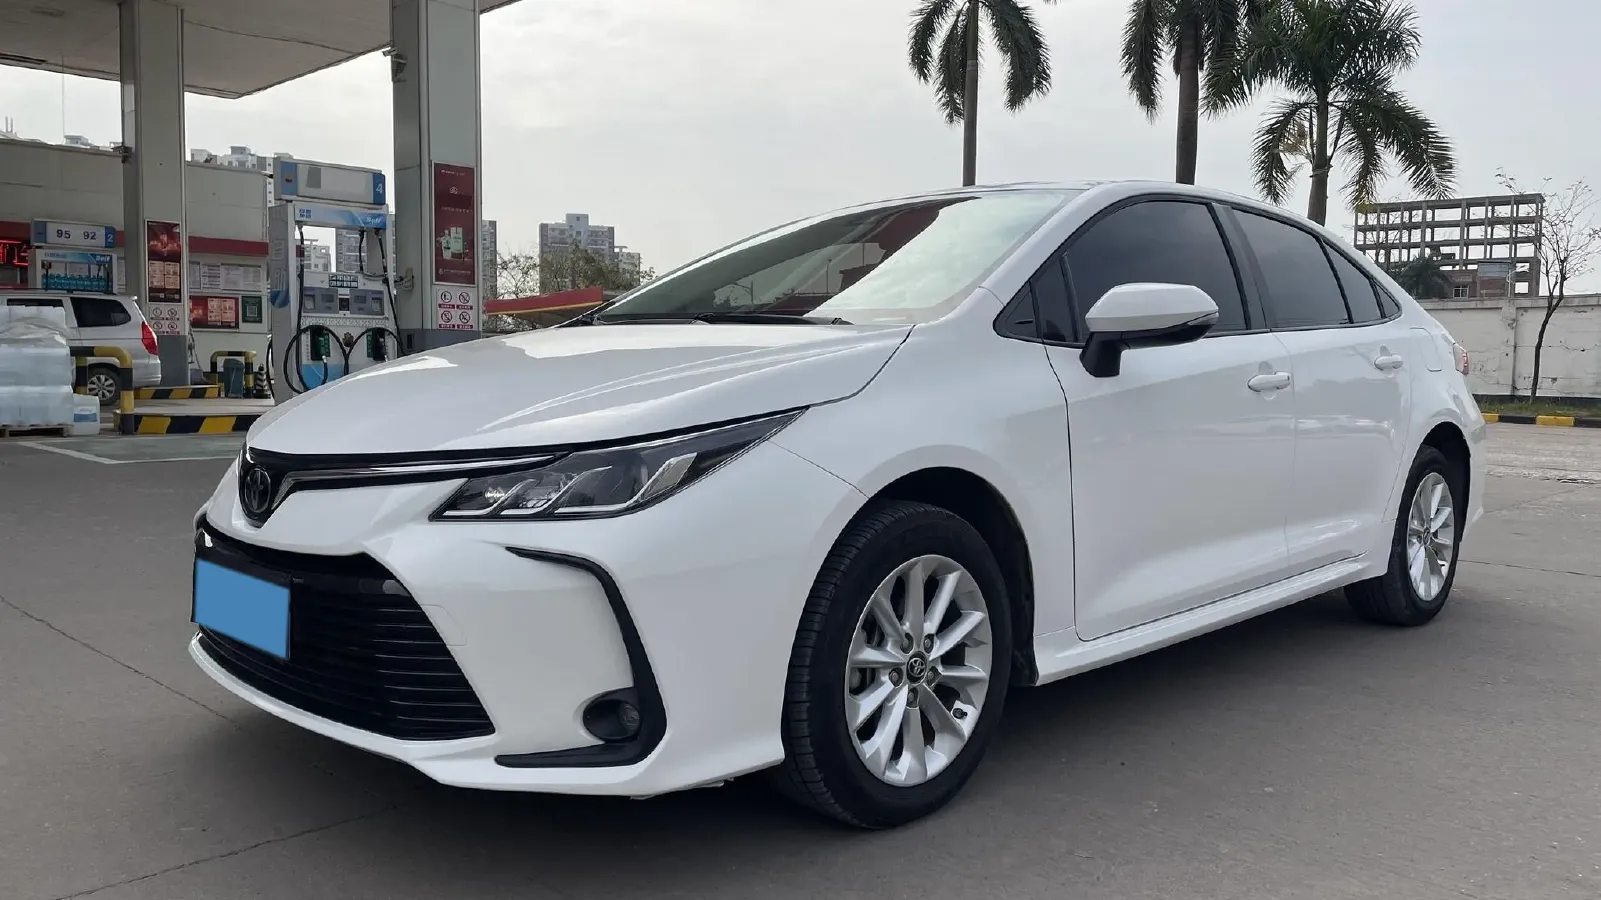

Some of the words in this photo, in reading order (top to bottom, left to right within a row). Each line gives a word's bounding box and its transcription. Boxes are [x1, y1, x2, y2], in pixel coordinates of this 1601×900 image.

[375, 183, 383, 194] 4
[56, 229, 71, 239] 95
[83, 231, 97, 240] 92
[107, 234, 114, 242] 2
